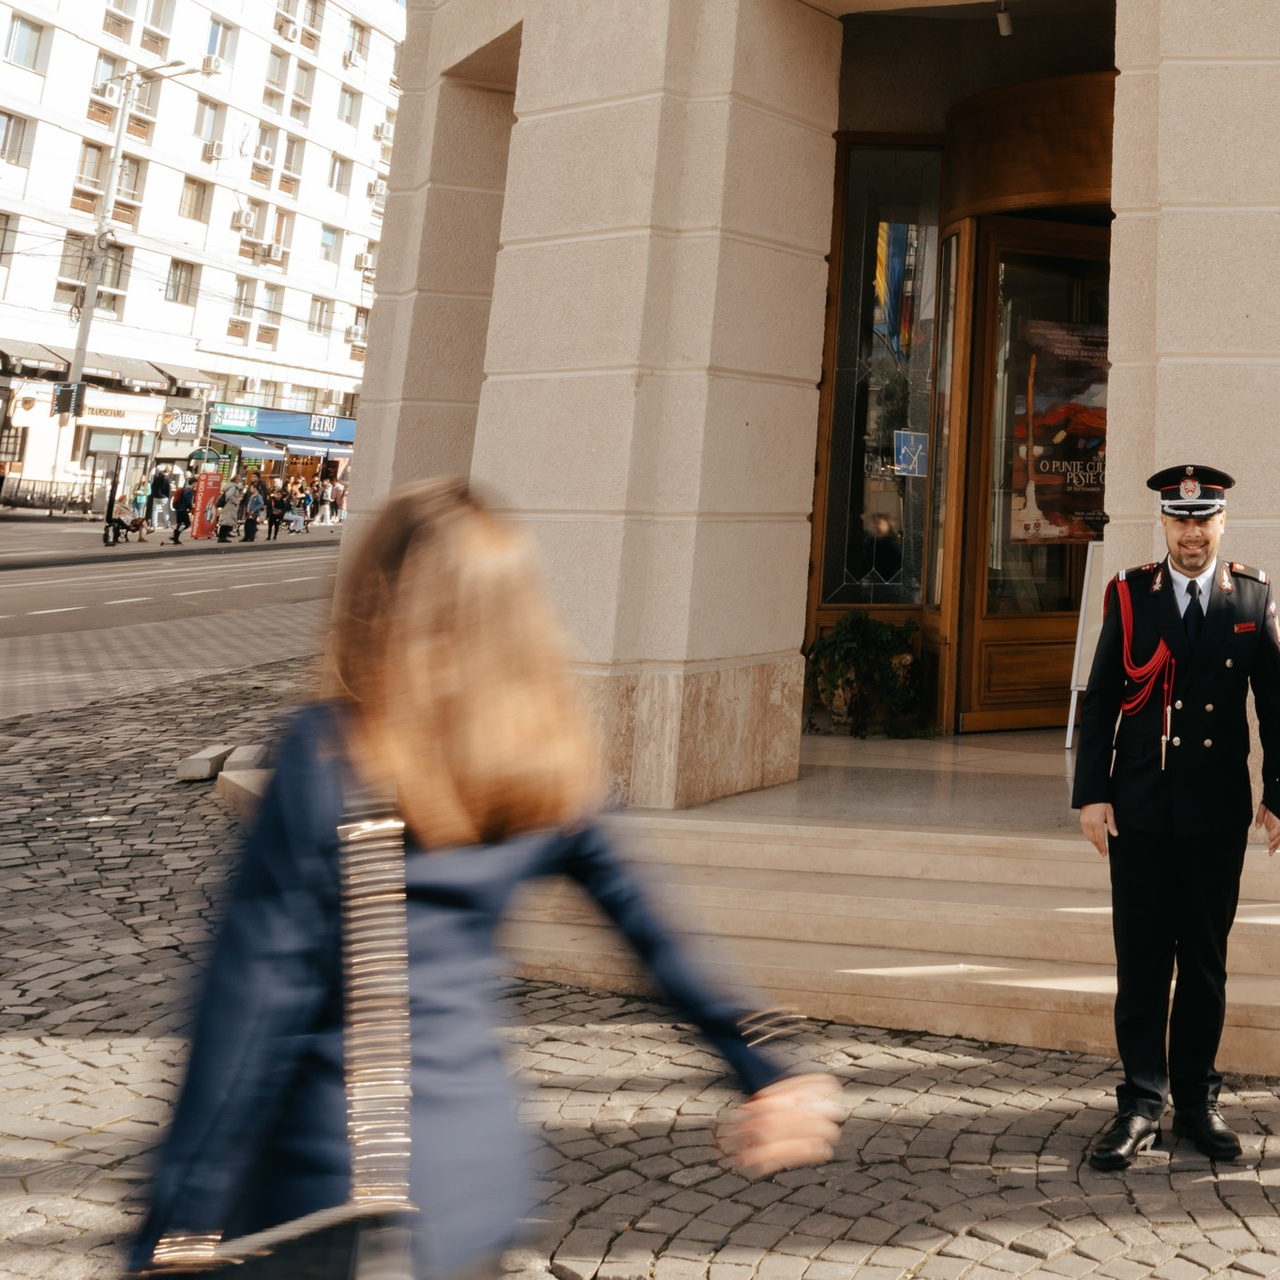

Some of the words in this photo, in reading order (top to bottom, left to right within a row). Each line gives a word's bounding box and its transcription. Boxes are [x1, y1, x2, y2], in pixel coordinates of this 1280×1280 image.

[87, 407, 126, 418] TRANSILVANIA
[182, 414, 198, 424] TEOS
[310, 415, 337, 432] PETRU
[180, 423, 197, 434] CAFE
[1040, 460, 1049, 472] O
[1052, 461, 1084, 472] PUNTE
[1066, 472, 1097, 486] PESTE
